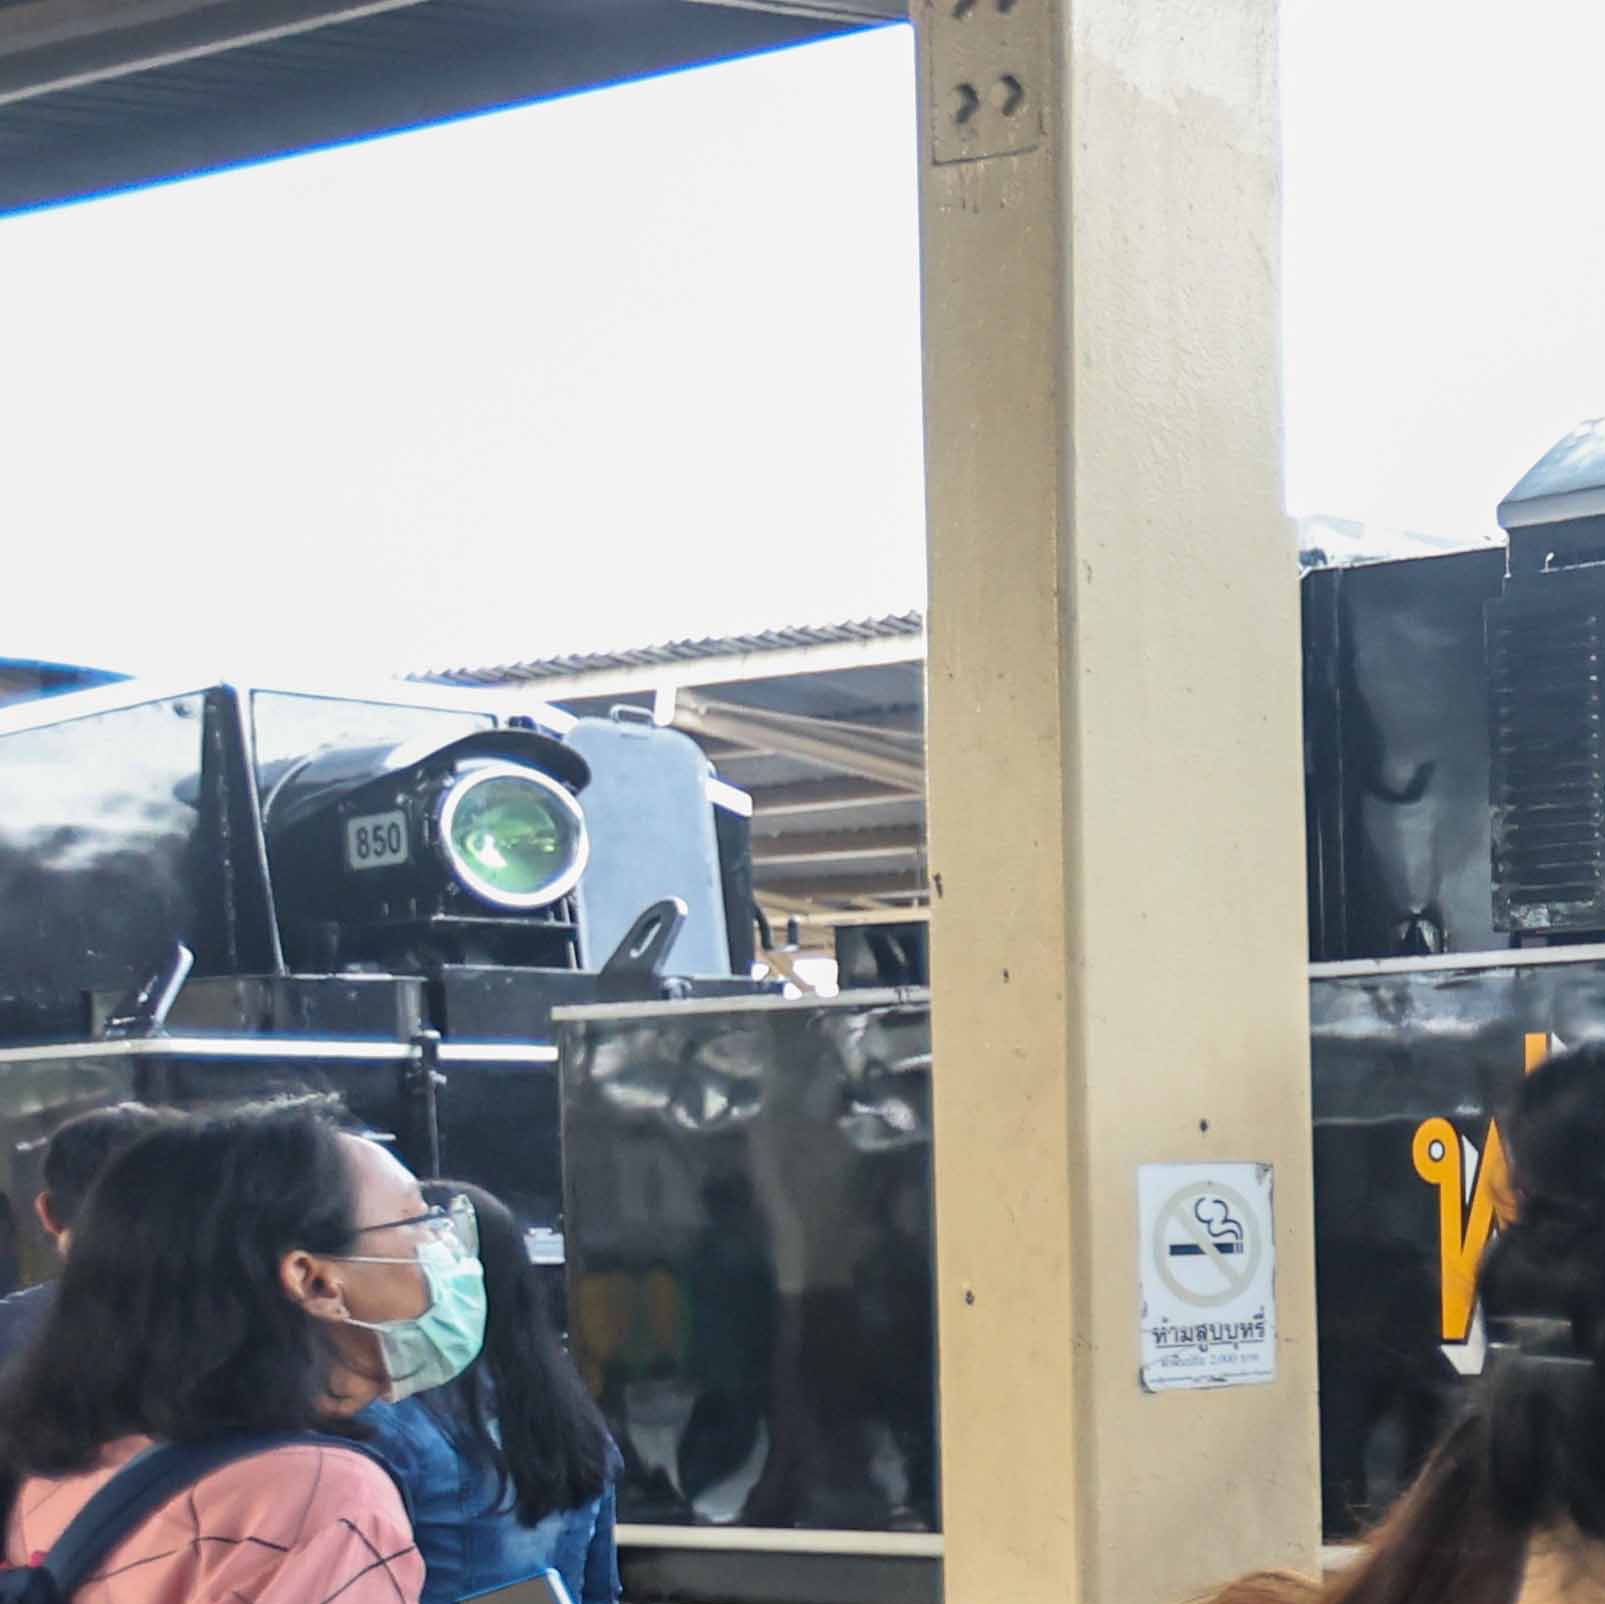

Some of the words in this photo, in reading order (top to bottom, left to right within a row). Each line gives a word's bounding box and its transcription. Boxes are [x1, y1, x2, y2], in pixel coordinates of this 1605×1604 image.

[356, 821, 402, 860] 850
[1152, 1305, 1265, 1352] ห้ามสูบบุหรี่
